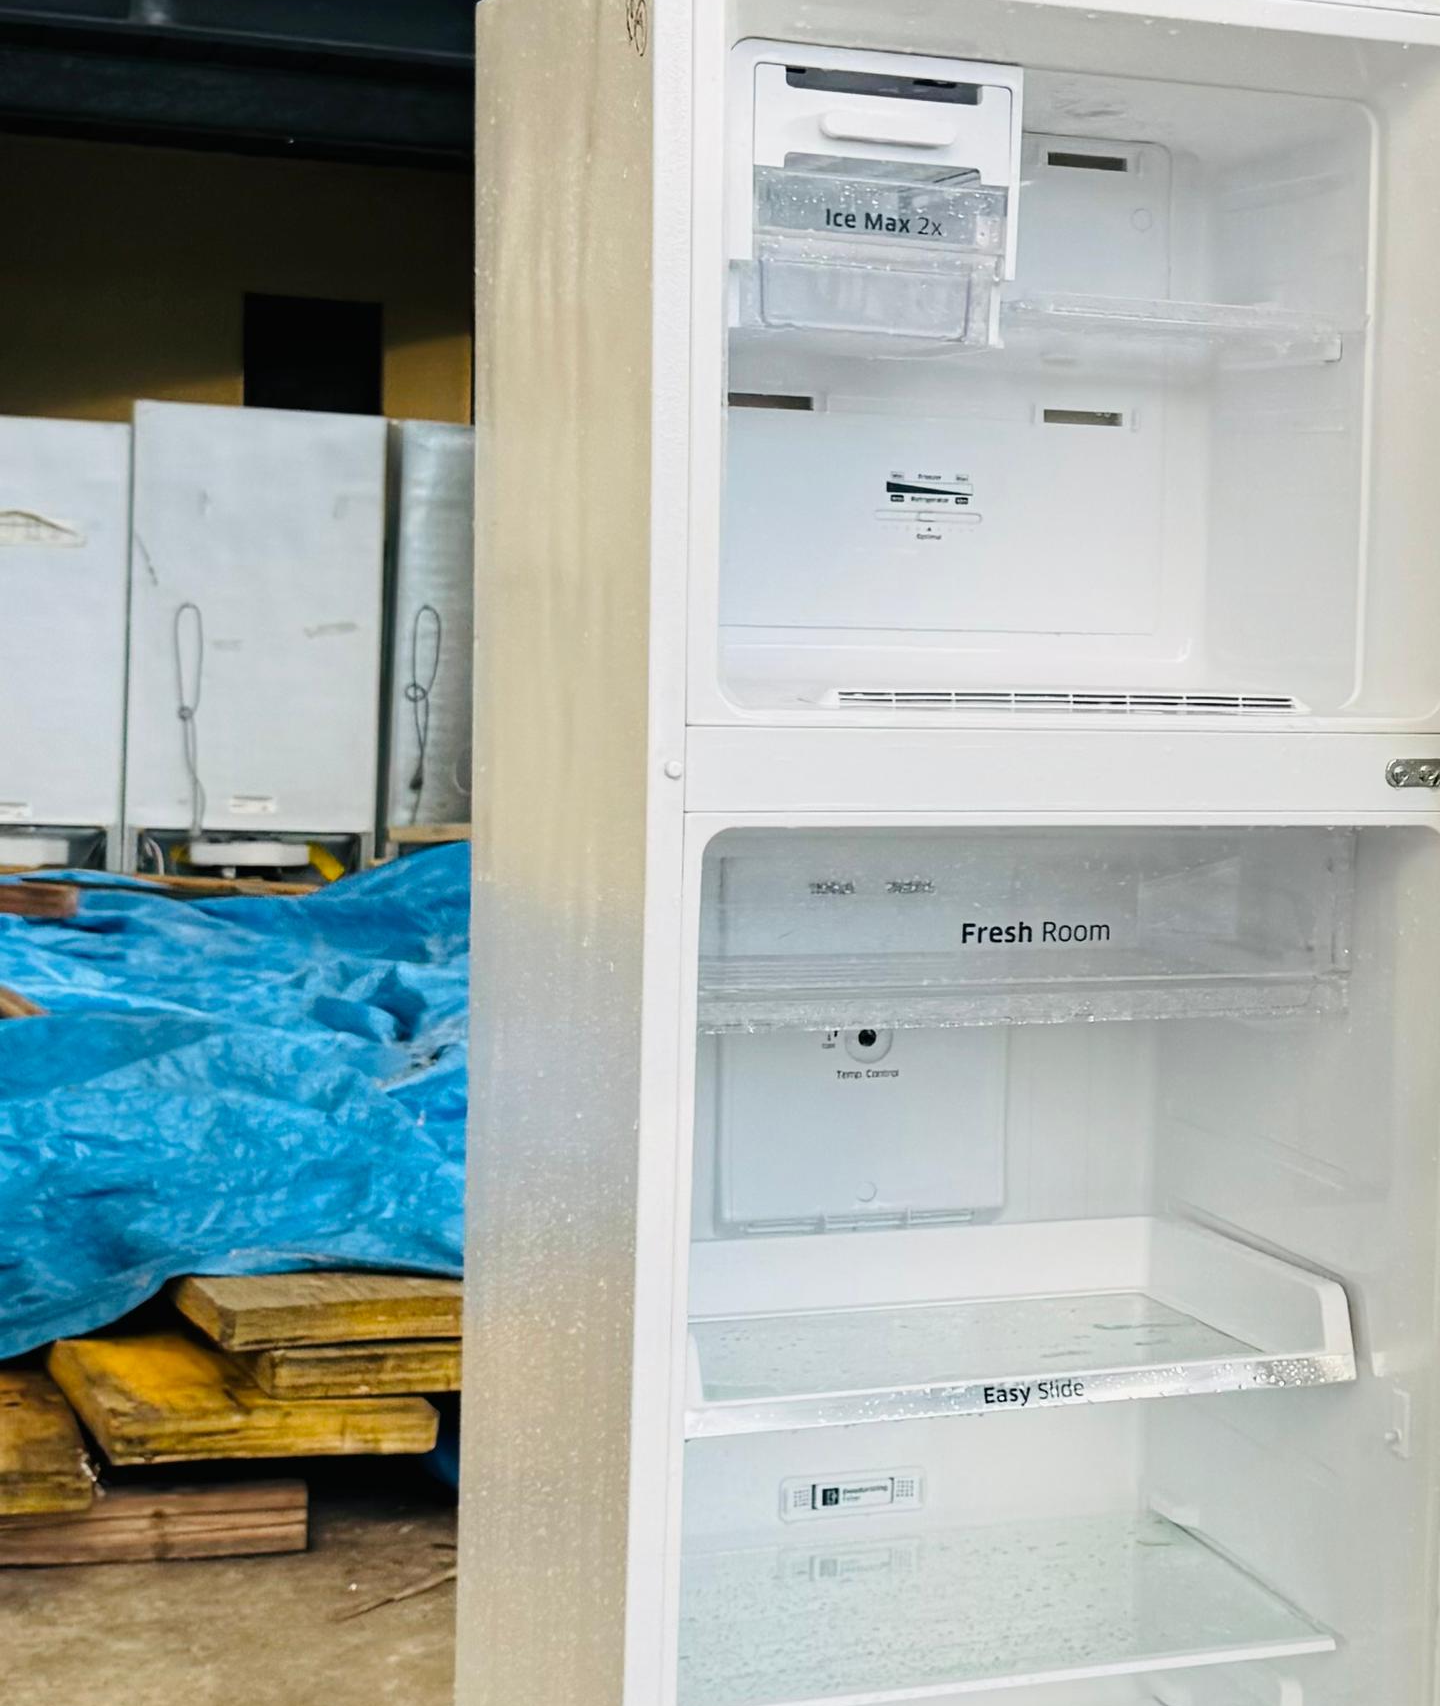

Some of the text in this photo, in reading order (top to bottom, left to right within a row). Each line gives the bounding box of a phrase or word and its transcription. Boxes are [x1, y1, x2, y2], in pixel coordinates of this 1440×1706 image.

[826, 208, 942, 236] Ice Max 2x
[961, 921, 1111, 944] Fresh Room
[983, 1379, 1085, 1407] Easy Slide
